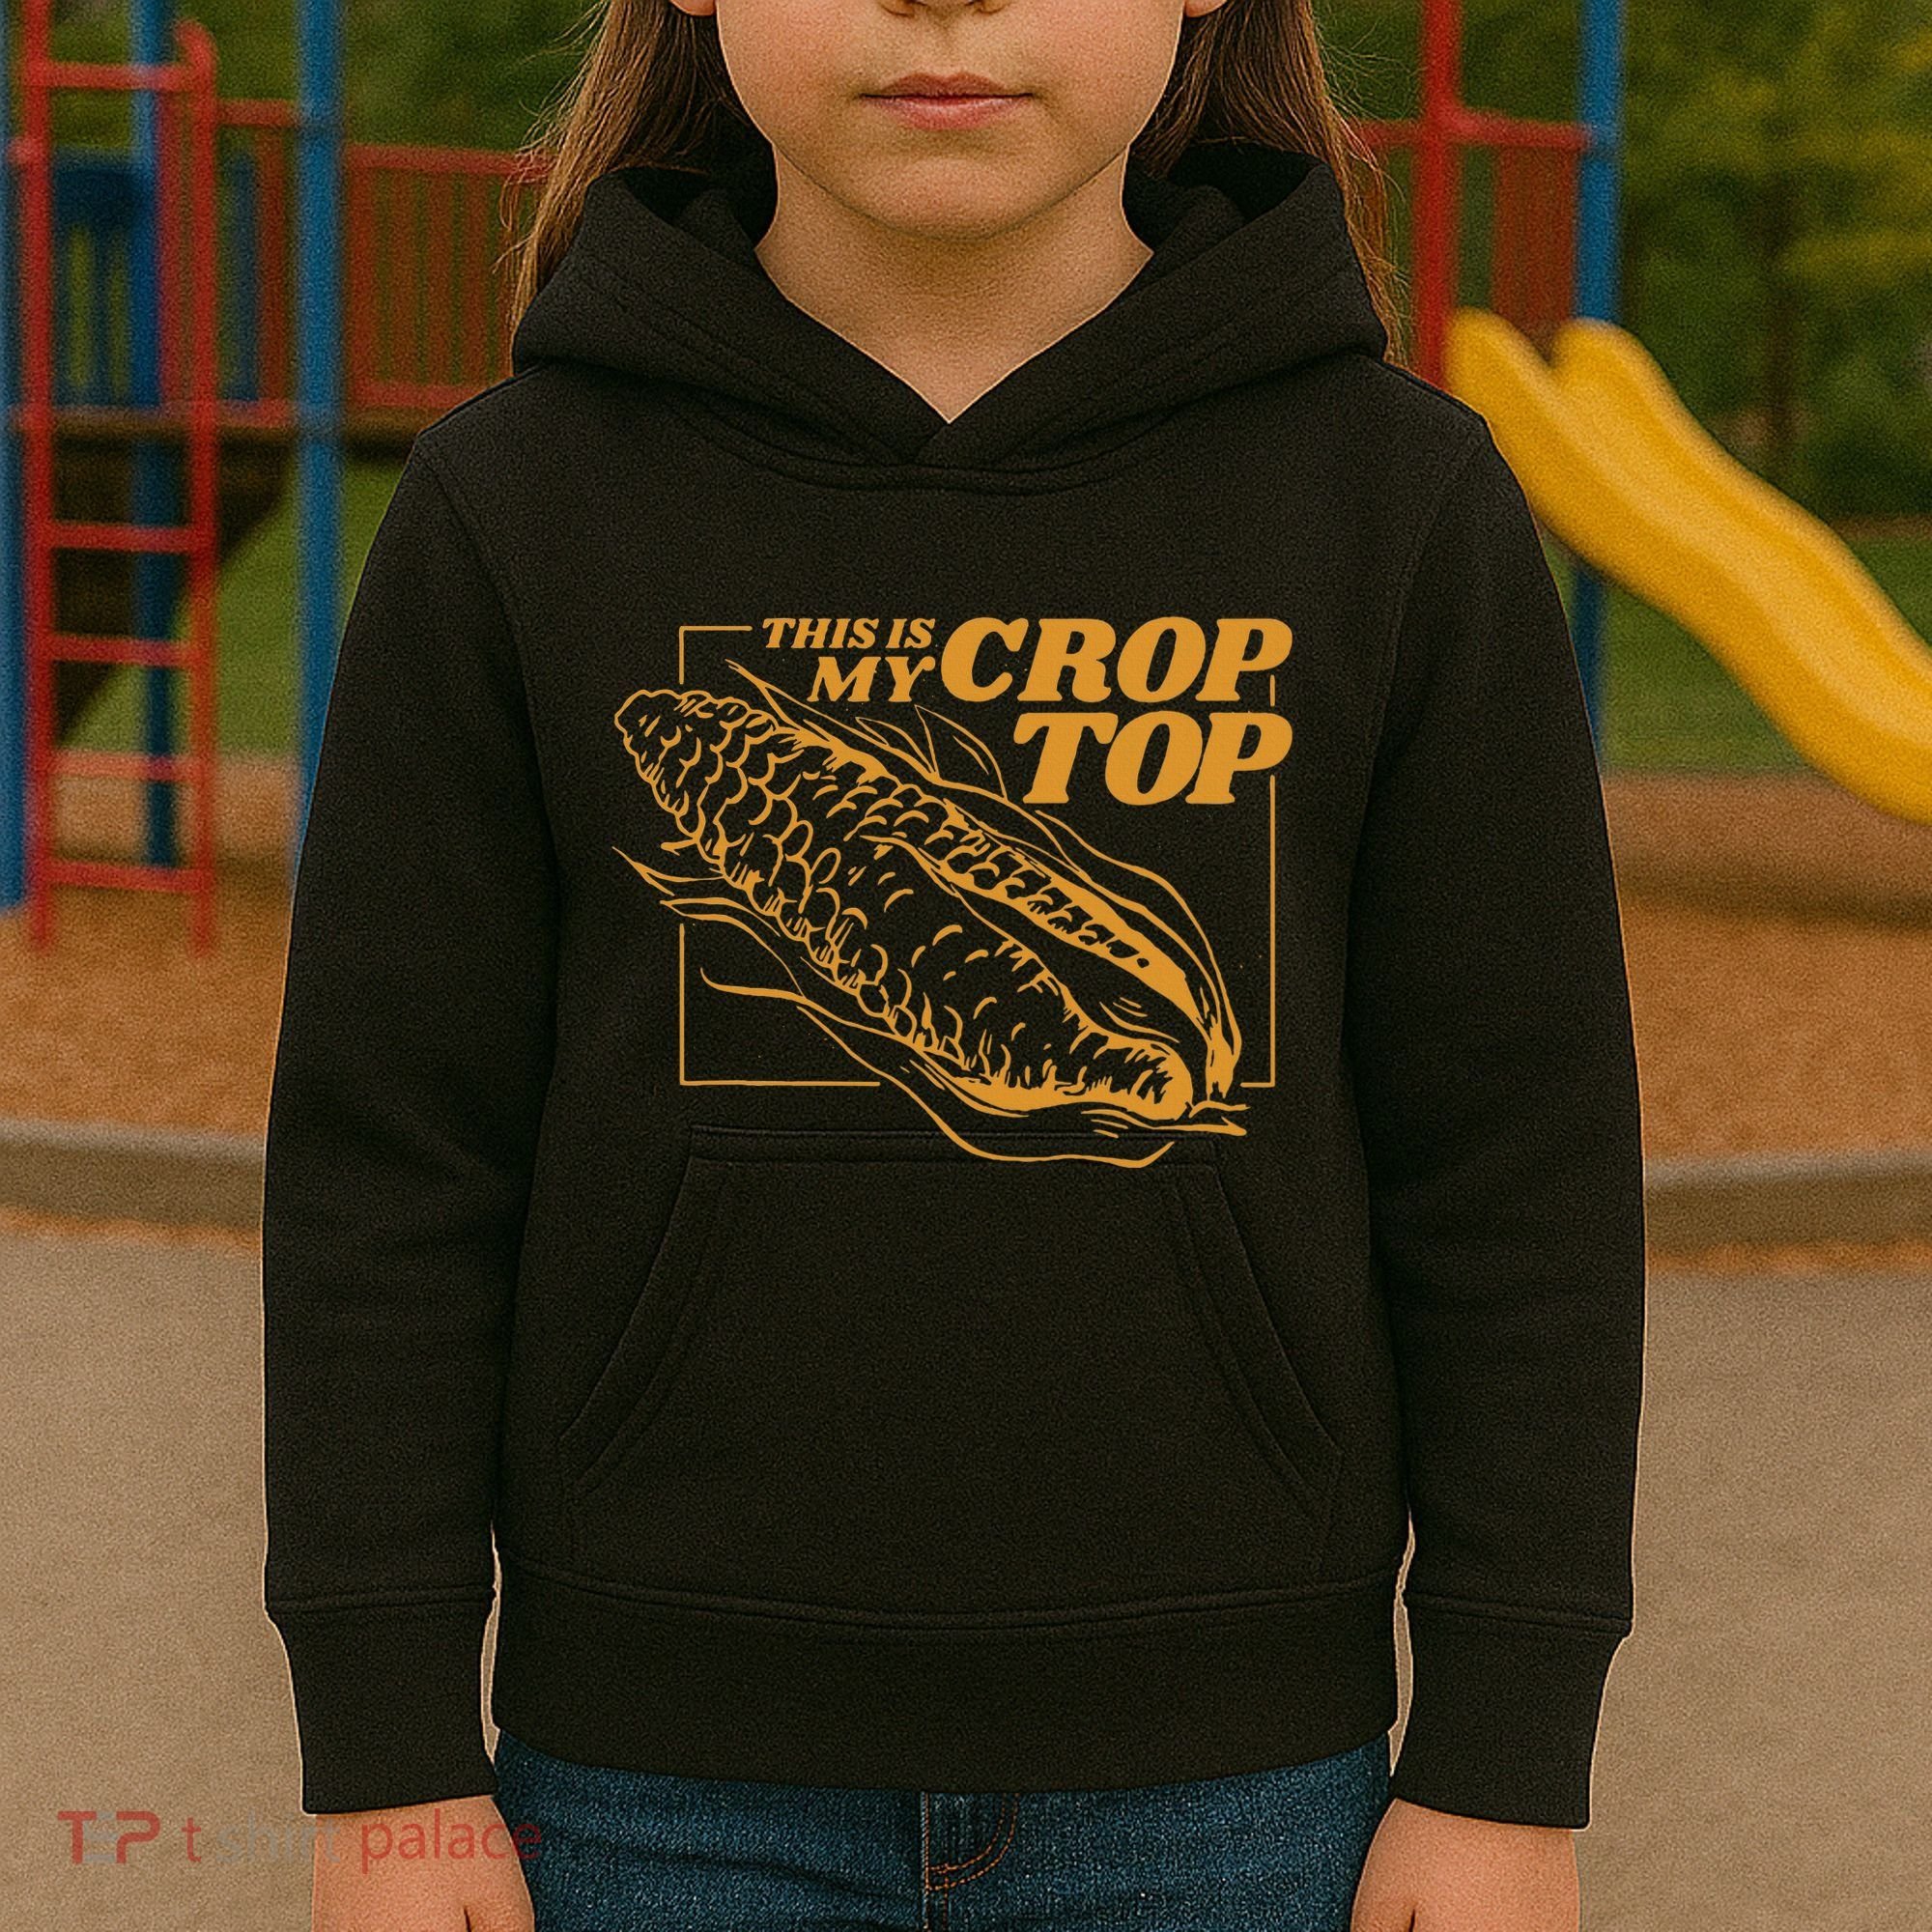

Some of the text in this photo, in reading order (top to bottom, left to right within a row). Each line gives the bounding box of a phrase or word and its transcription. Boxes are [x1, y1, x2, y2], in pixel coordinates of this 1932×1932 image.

[762, 617, 936, 649] THIS IS
[940, 615, 1293, 703] CROP
[806, 655, 936, 703] MY
[1013, 710, 1293, 806] TOP
